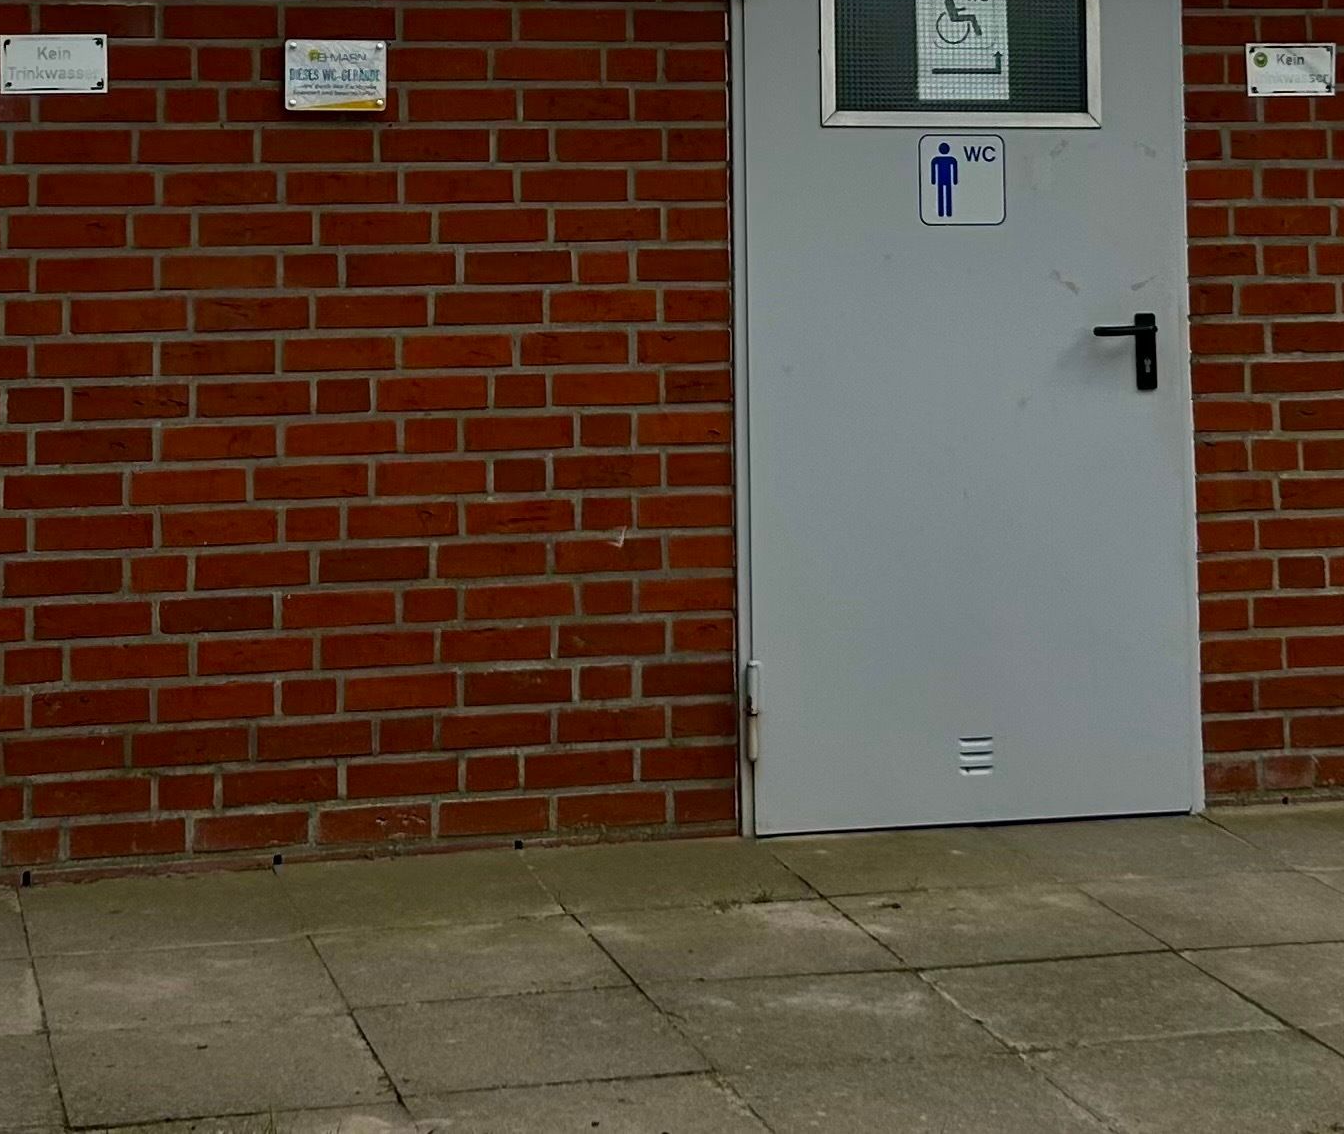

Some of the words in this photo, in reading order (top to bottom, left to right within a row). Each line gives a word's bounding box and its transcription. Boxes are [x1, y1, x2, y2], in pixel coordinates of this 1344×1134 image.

[37, 46, 71, 61] Kein
[1276, 53, 1305, 66] Kein
[963, 146, 996, 163] WC
